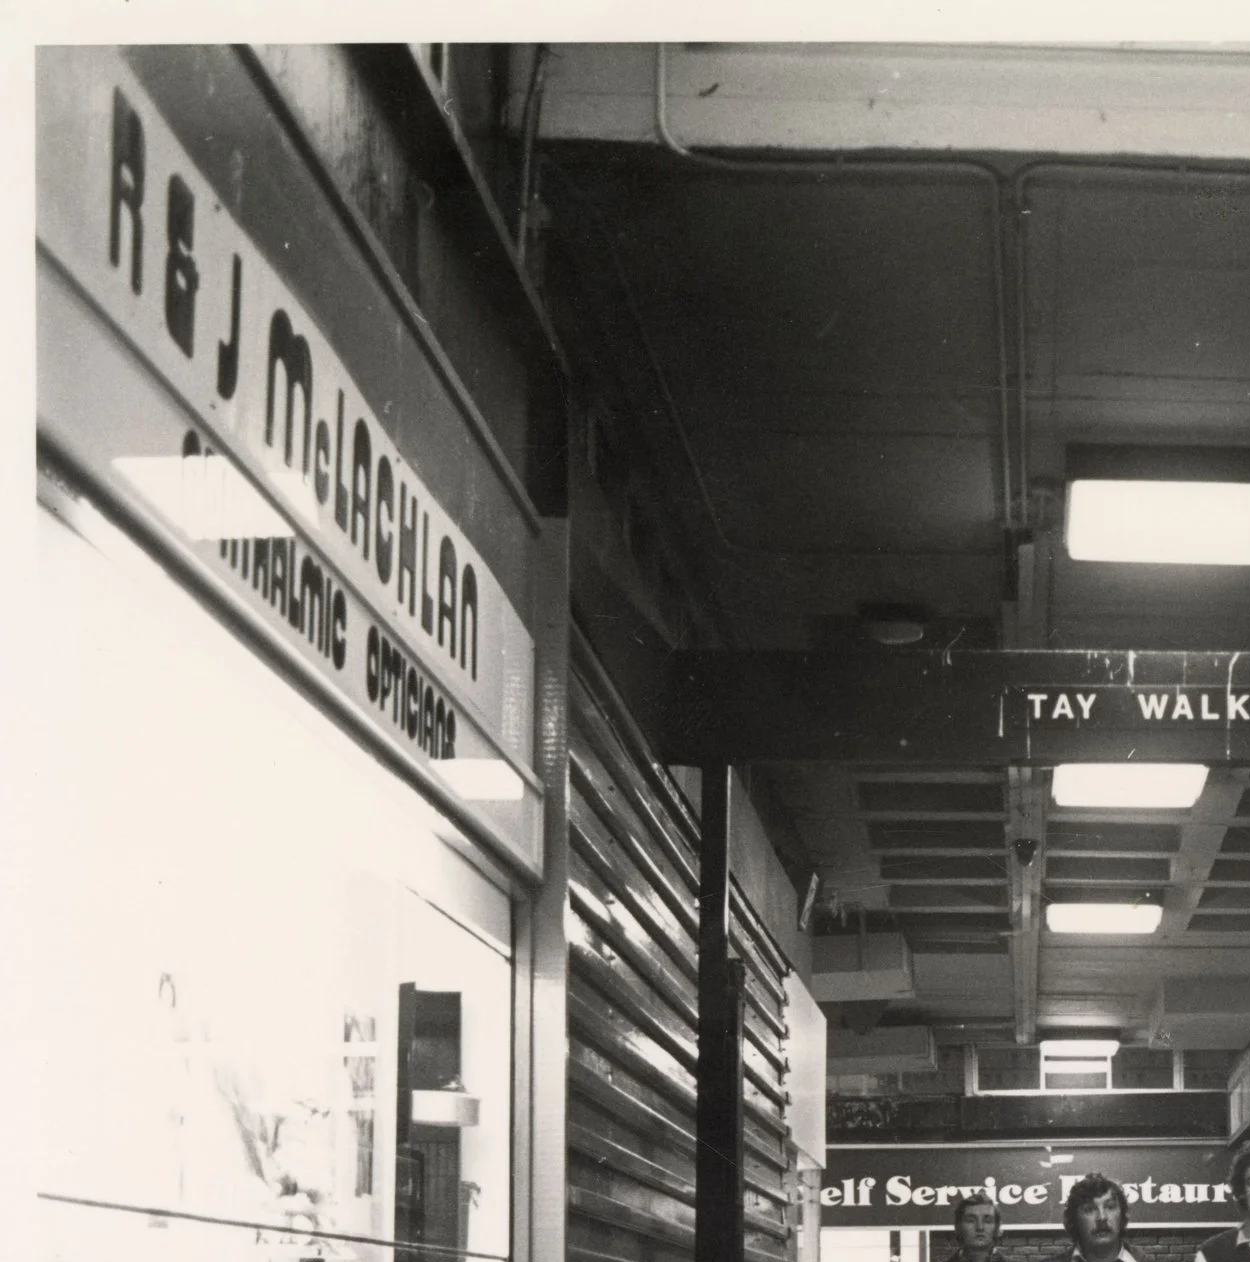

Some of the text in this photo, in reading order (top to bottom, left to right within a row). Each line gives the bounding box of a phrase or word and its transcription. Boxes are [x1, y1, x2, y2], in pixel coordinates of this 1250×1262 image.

[110, 85, 145, 296] R
[165, 173, 199, 360] &
[216, 251, 242, 400] J
[1027, 693, 1250, 720] TAY WALK
[798, 1177, 876, 1206] elf
